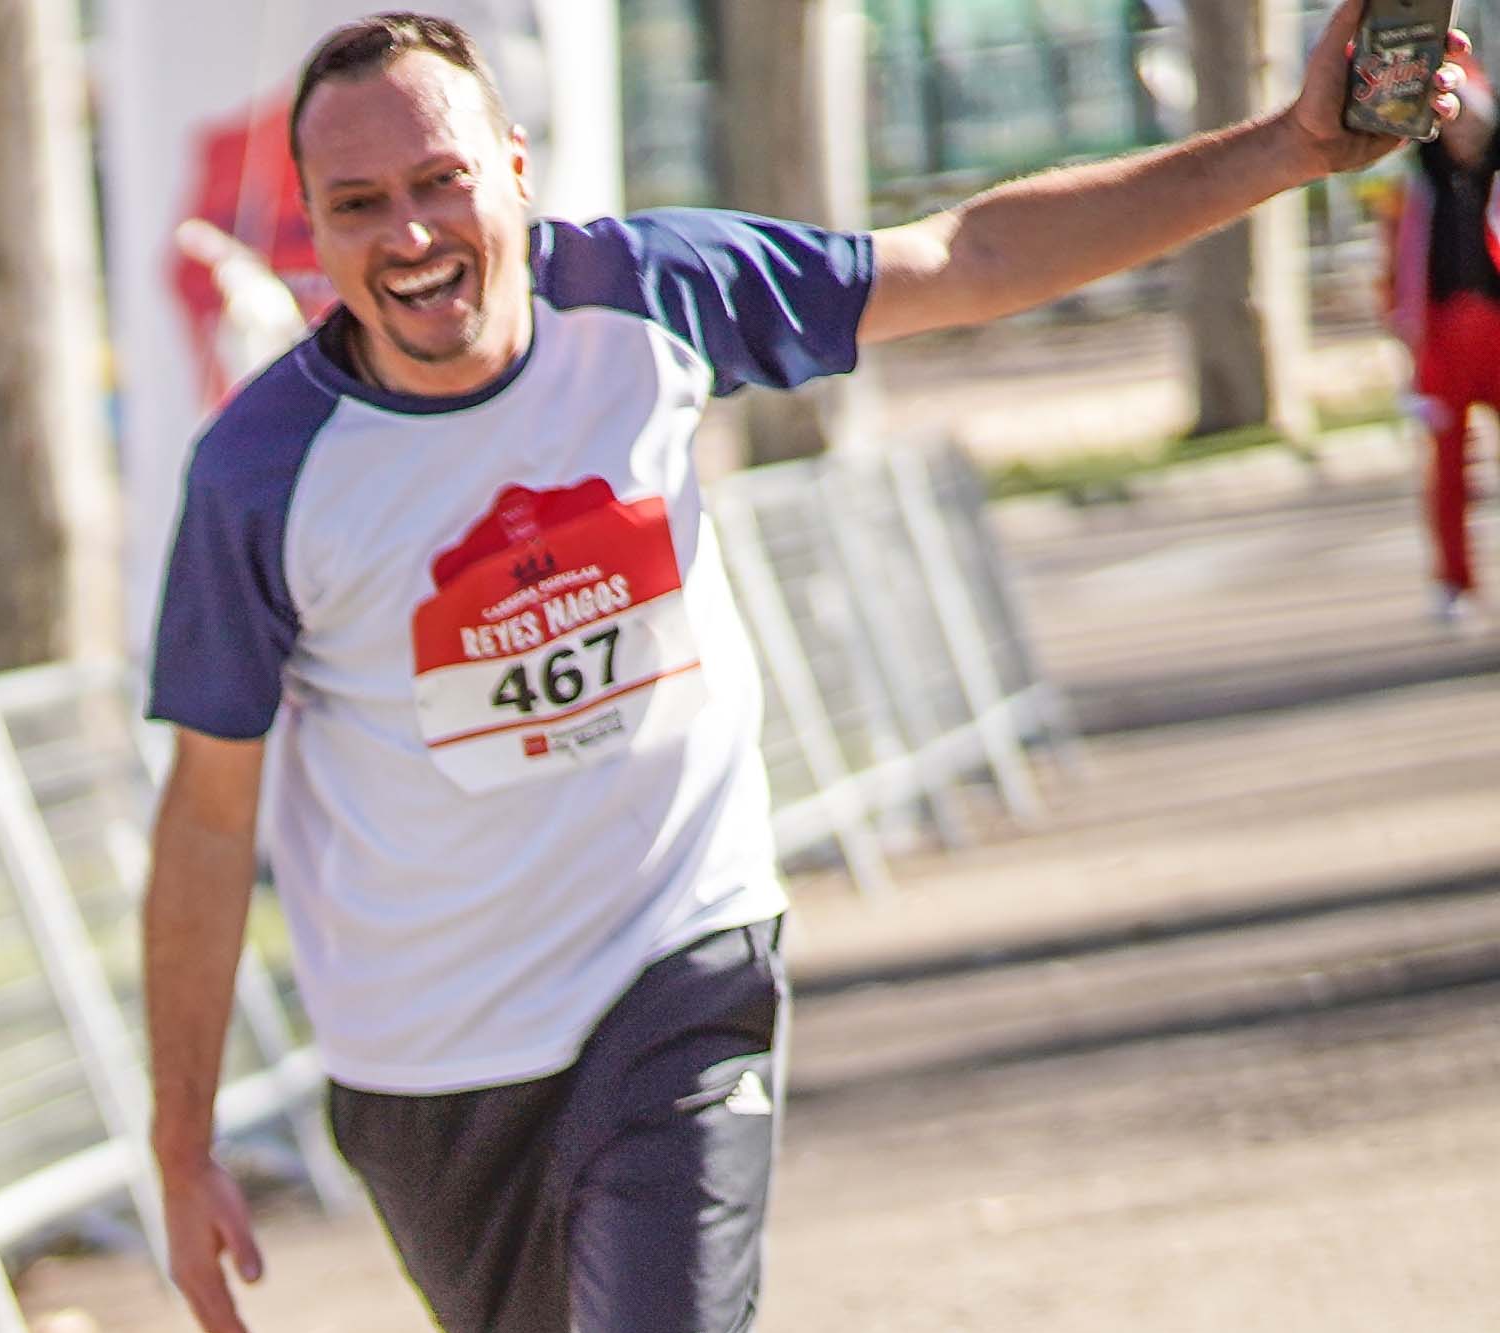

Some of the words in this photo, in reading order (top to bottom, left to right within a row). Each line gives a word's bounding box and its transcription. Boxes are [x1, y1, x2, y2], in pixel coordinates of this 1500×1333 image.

[460, 610, 543, 659] REYES
[541, 573, 631, 636] MAGOS
[491, 624, 619, 713] 467
